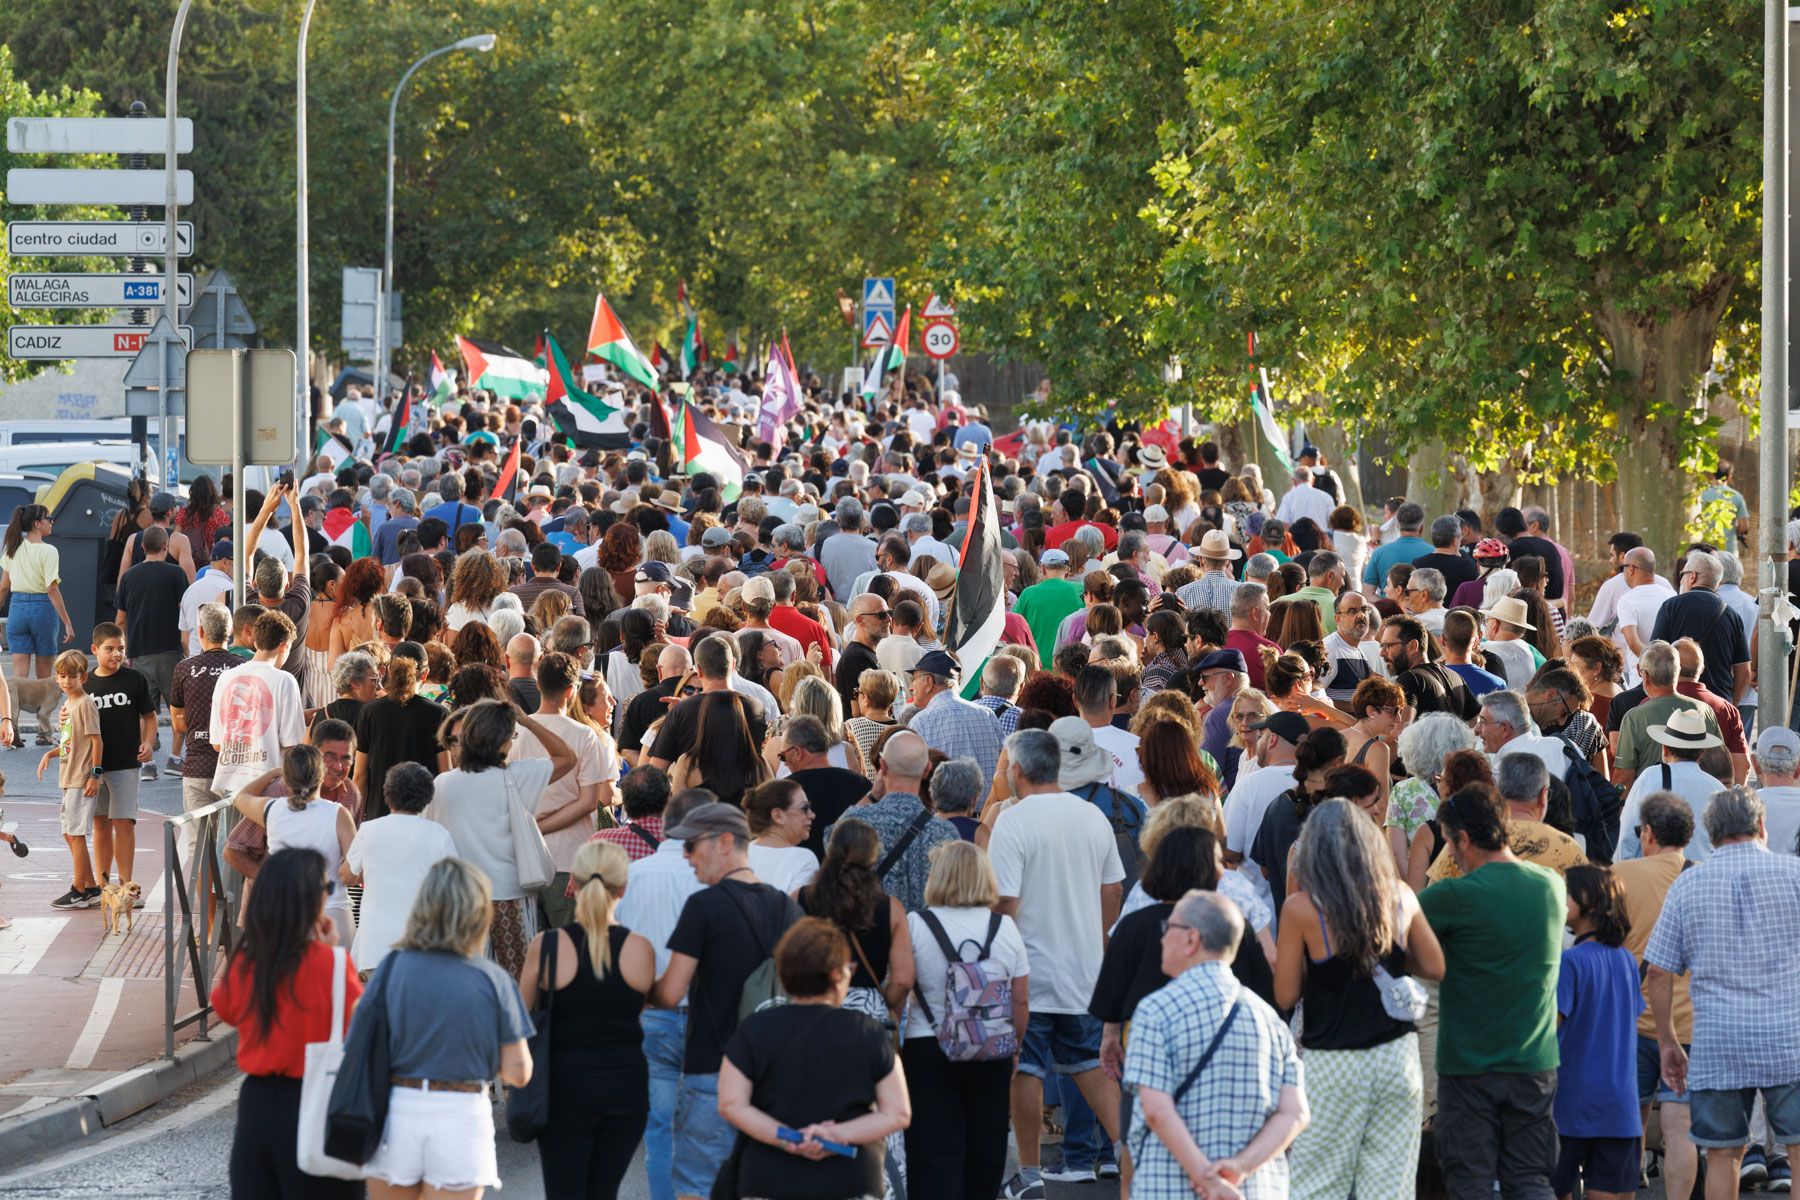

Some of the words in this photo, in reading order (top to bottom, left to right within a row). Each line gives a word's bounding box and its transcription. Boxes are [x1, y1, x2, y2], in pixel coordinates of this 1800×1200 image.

[15, 233, 62, 245] centro
[67, 232, 117, 245] ciudad
[15, 279, 70, 290] MALAGA
[126, 285, 158, 297] A-381
[15, 291, 89, 302] ALGECIRAS
[15, 336, 62, 349] CADIZ
[118, 336, 147, 349] N-I
[930, 333, 951, 346] 30
